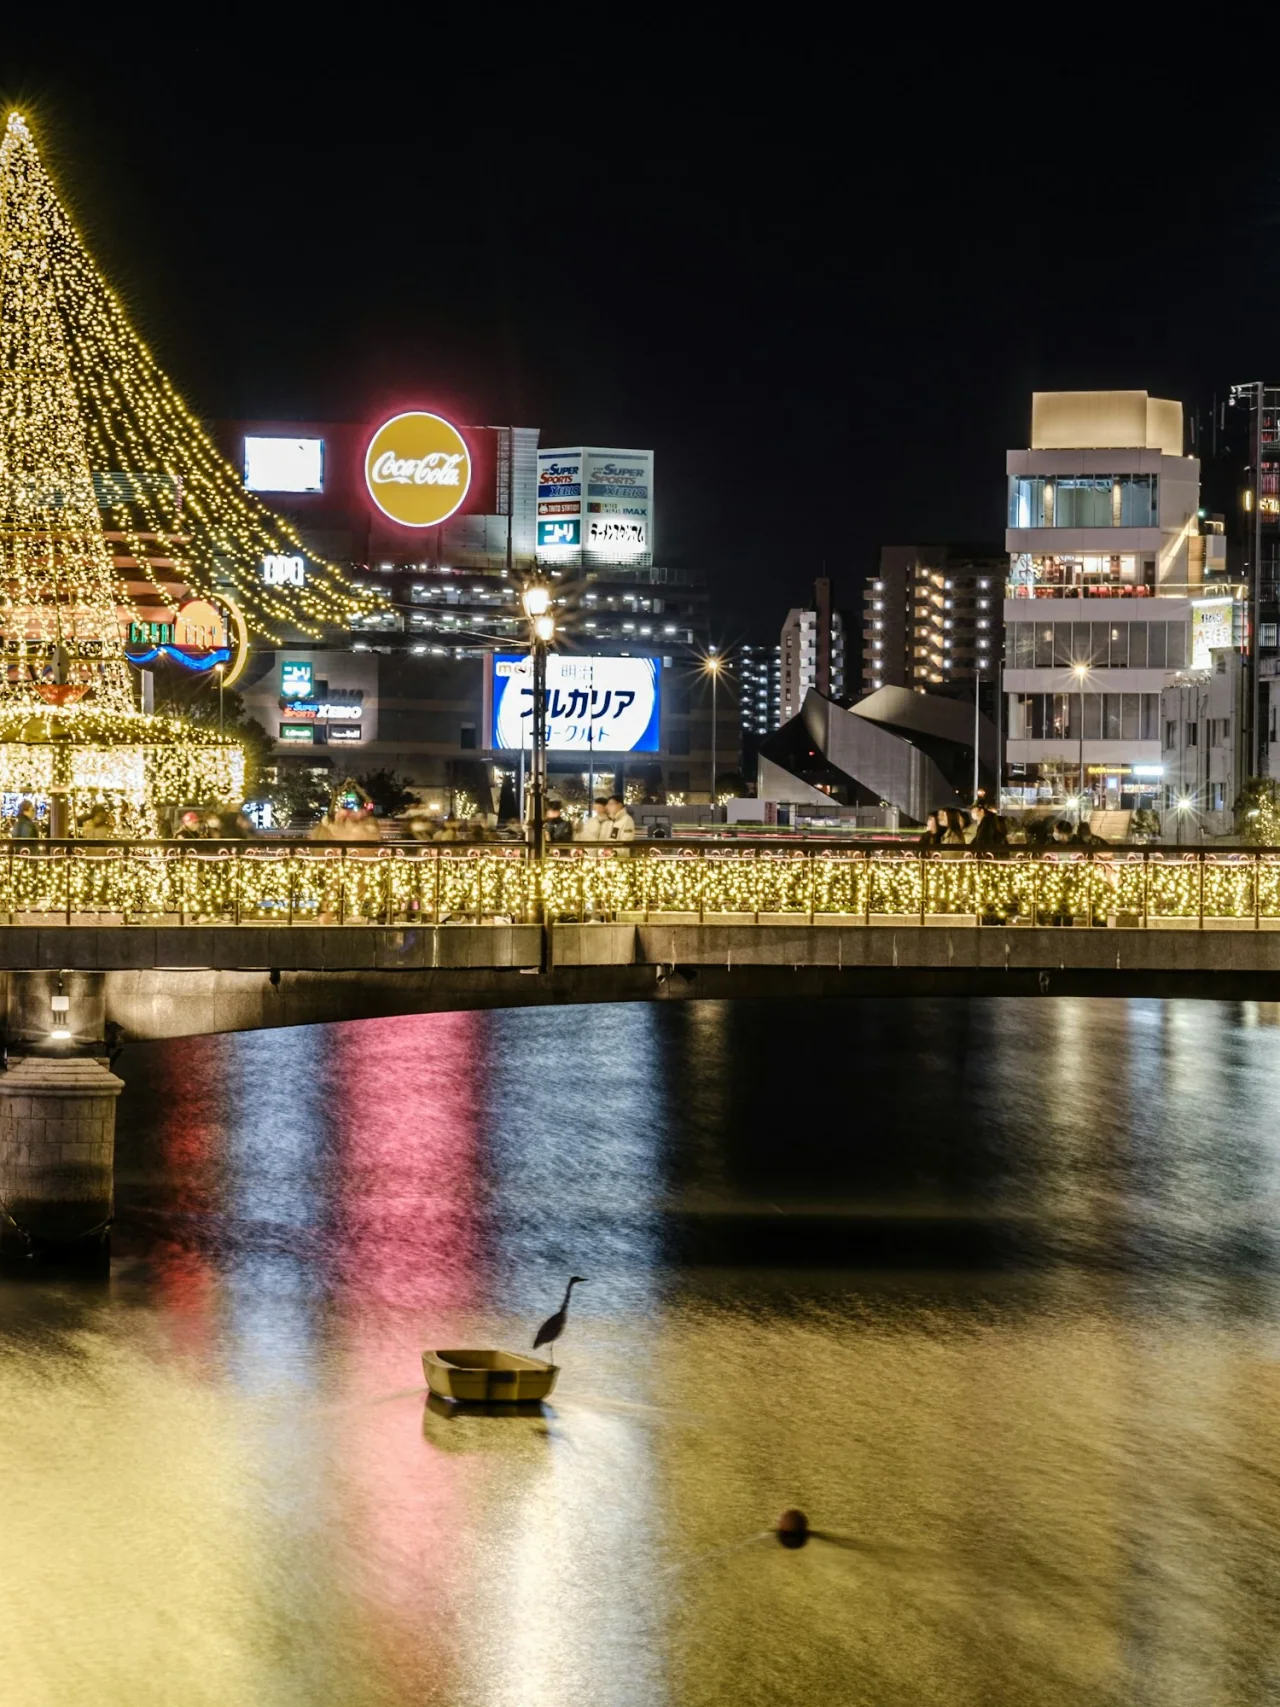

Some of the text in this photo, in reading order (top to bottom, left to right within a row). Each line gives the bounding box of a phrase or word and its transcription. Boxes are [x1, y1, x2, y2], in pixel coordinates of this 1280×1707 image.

[372, 451, 465, 486] Coca-Cola
[539, 472, 573, 485] SPORTS
[622, 508, 648, 516] IMAX
[543, 523, 574, 544] ニトリ
